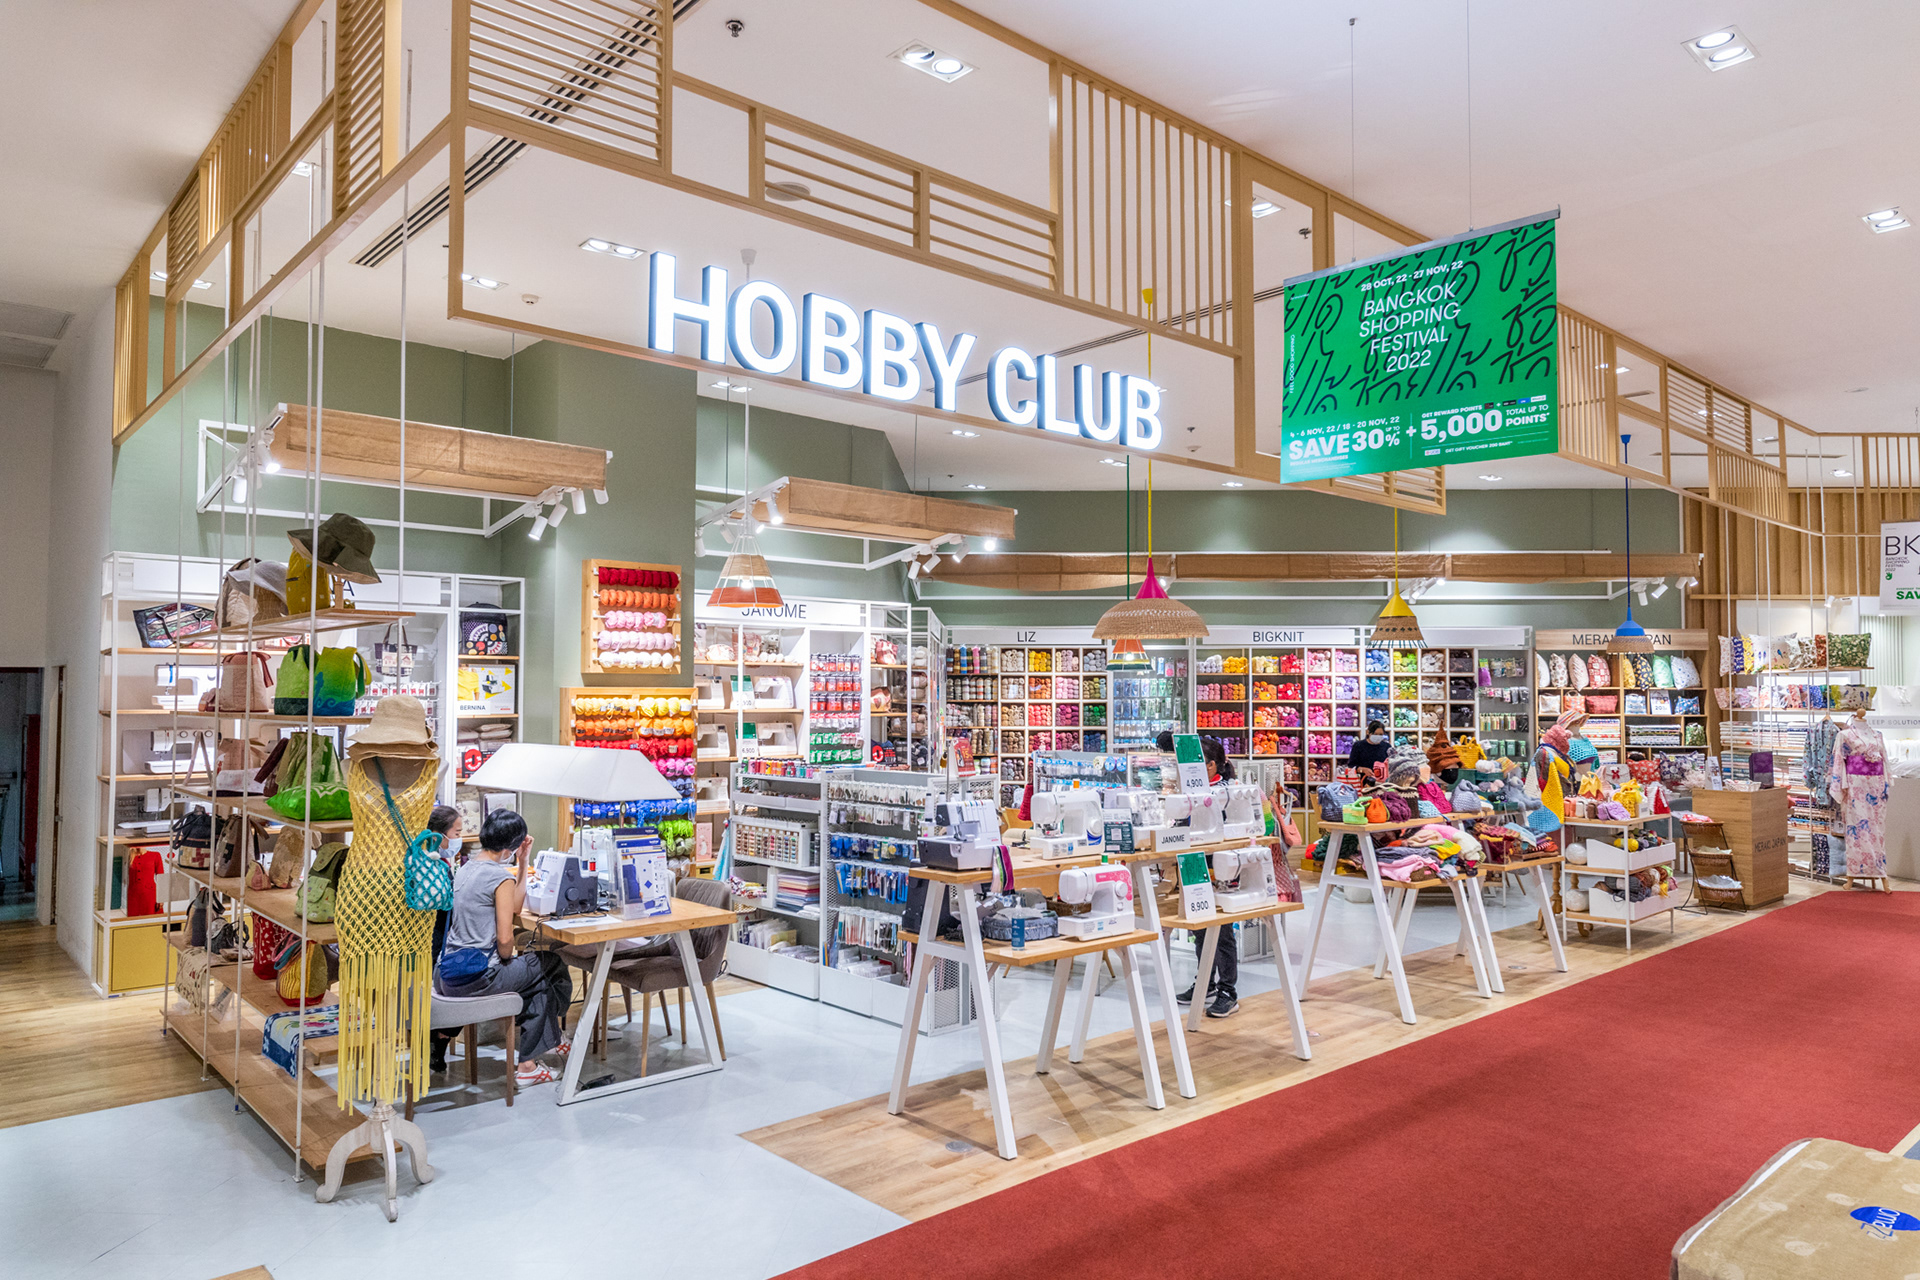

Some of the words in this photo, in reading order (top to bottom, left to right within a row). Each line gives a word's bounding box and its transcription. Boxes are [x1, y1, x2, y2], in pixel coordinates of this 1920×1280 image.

[1361, 283, 1372, 292] 28
[1373, 277, 1395, 289] OCT,
[1396, 274, 1407, 283] 22
[1413, 269, 1424, 280] 27
[1426, 264, 1450, 276] NOV,
[1451, 260, 1464, 270] 22
[1363, 280, 1457, 317] BANGKOK
[1359, 301, 1461, 338] SHOPPING
[1370, 325, 1449, 355] FESTIVAL
[648, 251, 977, 412] HOBBY
[987, 347, 1163, 450] CLUB
[1386, 349, 1432, 373] 2022
[1433, 408, 1460, 417] REWARD
[1460, 405, 1483, 413] POINTS
[1506, 408, 1527, 416] TOTAL
[1527, 405, 1537, 413] UP
[1357, 421, 1367, 429] 20
[1420, 409, 1503, 443] 5,000
[1289, 433, 1350, 460] SAVE
[741, 604, 807, 619] JANOME
[1017, 631, 1036, 642] LIZ
[1252, 631, 1305, 642] BIGKNIT
[1186, 778, 1203, 788] 4,900
[1161, 834, 1185, 844] JANOME
[1190, 900, 1209, 912] 8,900
